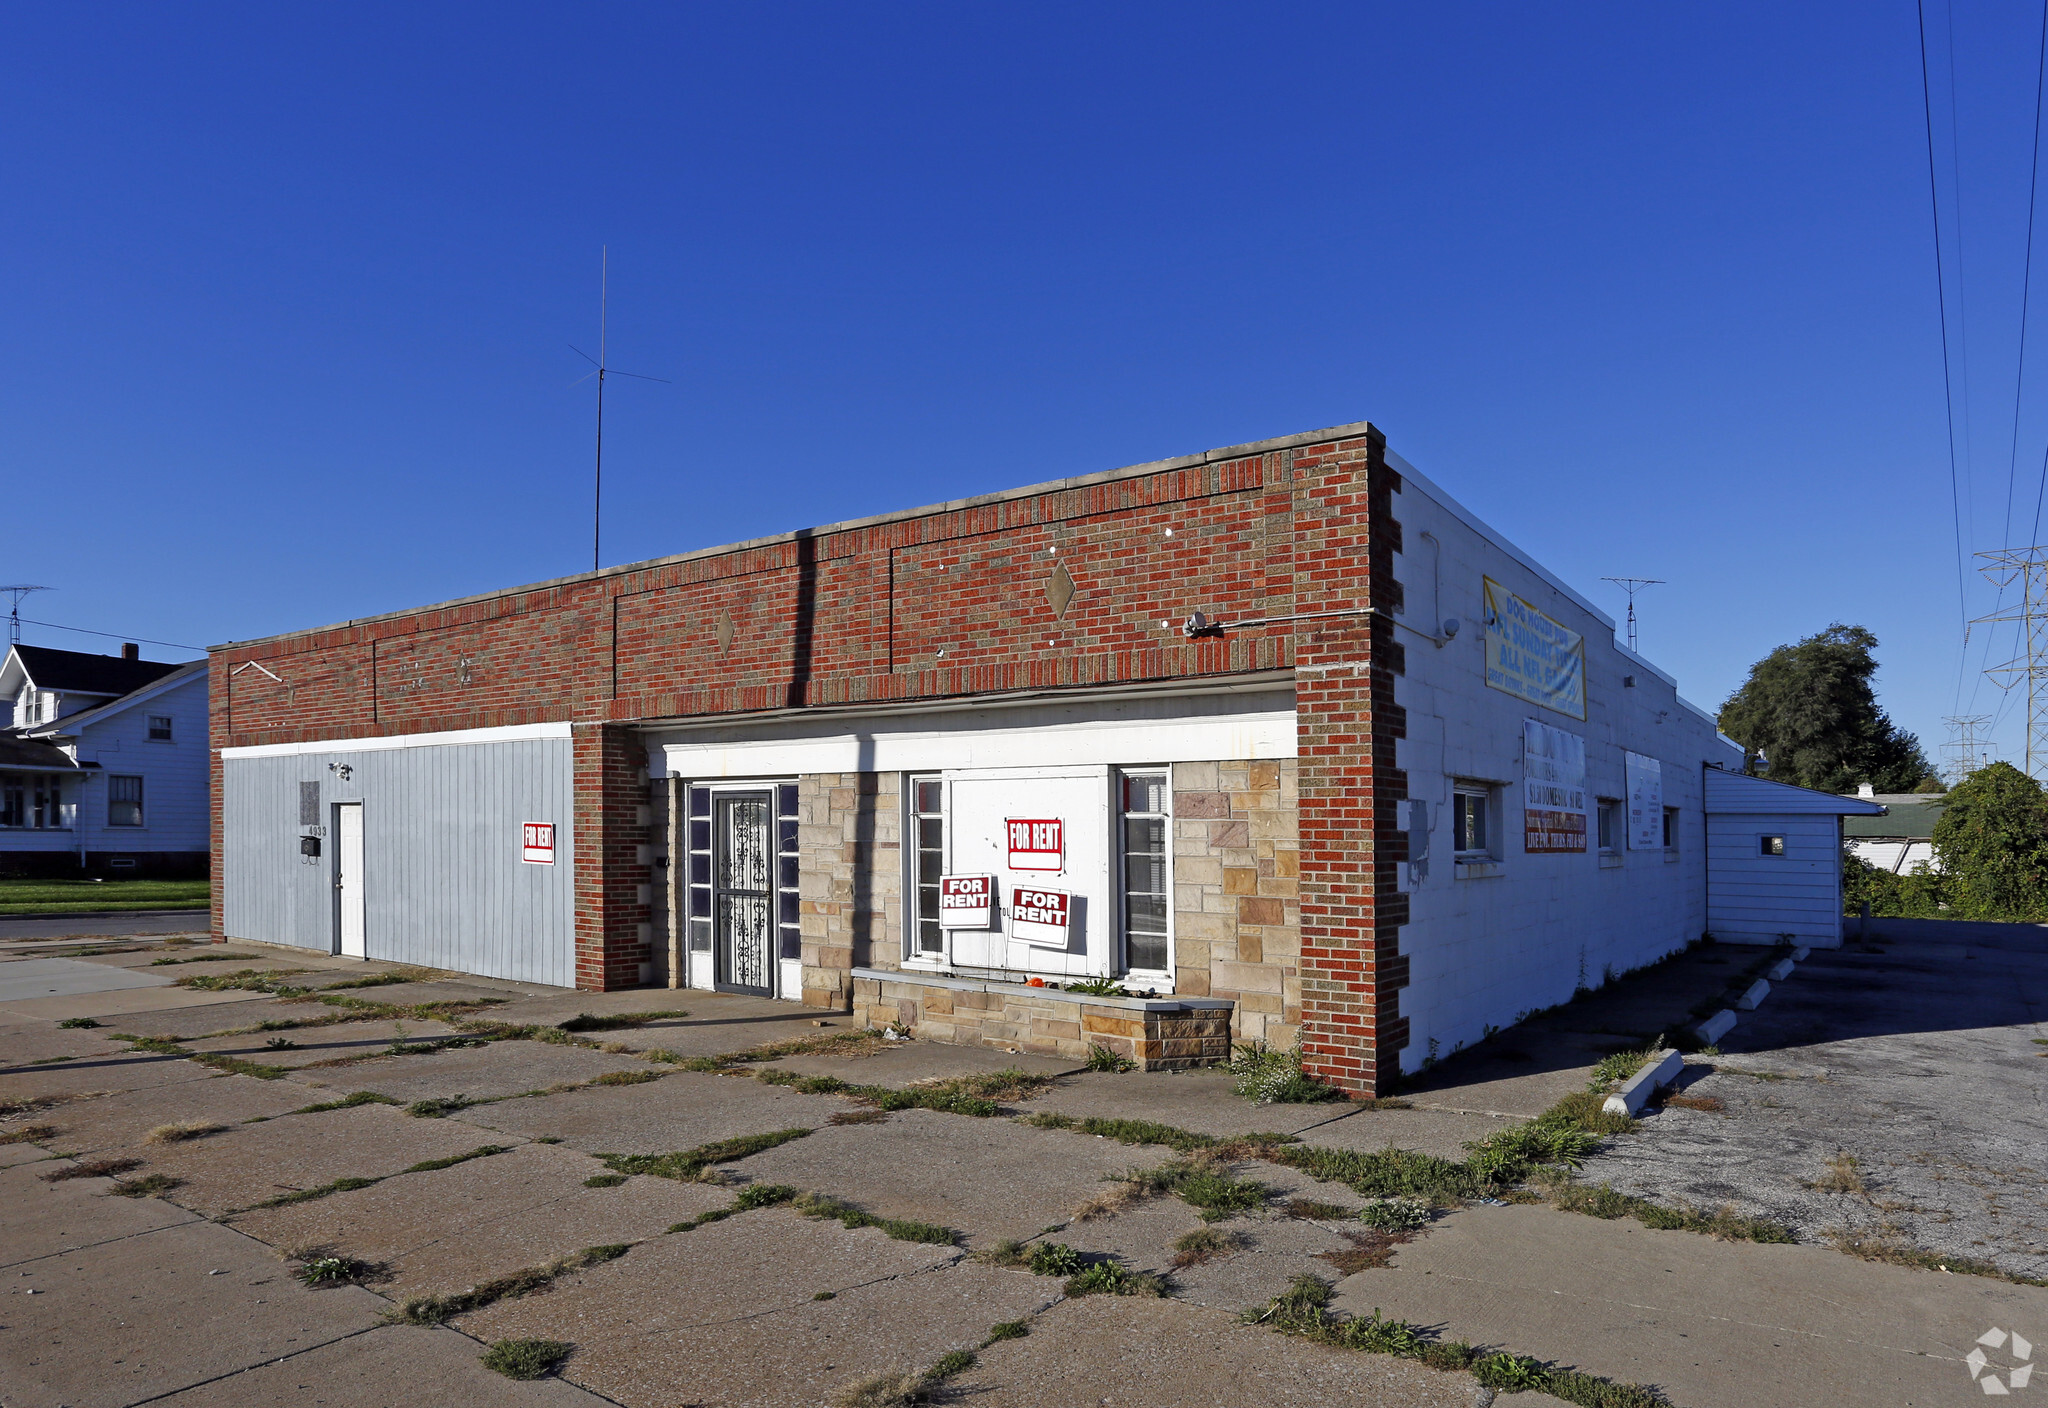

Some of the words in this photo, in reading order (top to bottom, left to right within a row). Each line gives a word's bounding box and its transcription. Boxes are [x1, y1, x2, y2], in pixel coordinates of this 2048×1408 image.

[1507, 596, 1525, 622] DOG
[1528, 612, 1553, 638] HOUSE
[1486, 606, 1510, 640] NFL
[1512, 622, 1553, 662] SUNDAY
[1500, 644, 1520, 673] ALL
[1523, 655, 1542, 684] NFL
[309, 826, 326, 836] 4933
[525, 826, 536, 846] FOR
[537, 827, 551, 847] RENT
[1009, 823, 1030, 849] FOR
[1032, 823, 1060, 850] RENT
[1527, 832, 1538, 848] LIVE
[949, 880, 983, 893] FOR
[943, 893, 987, 908] RENT
[1021, 891, 1060, 909] FOR
[1014, 906, 1065, 925] RENT
